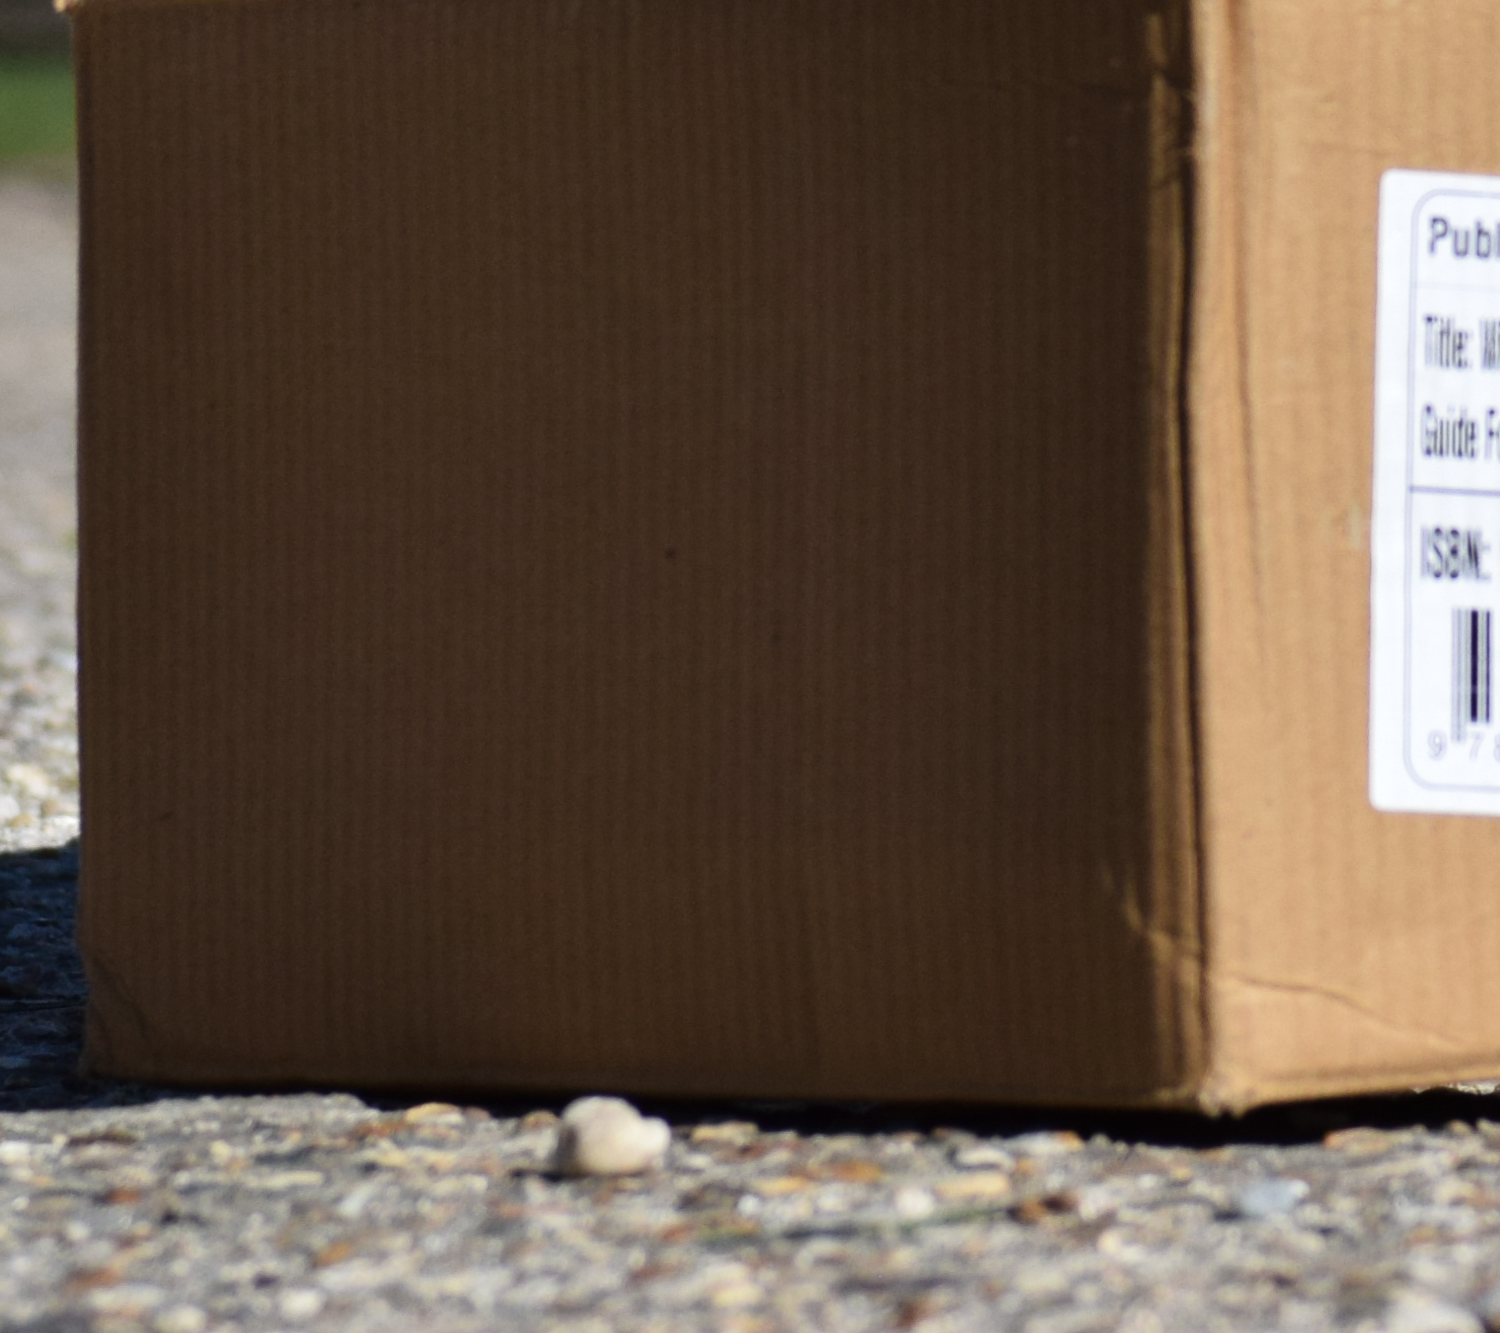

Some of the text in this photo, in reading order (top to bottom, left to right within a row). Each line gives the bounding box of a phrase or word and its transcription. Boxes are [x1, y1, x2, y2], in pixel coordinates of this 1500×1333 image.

[1423, 314, 1470, 370] Title:
[1421, 404, 1477, 459] Guide
[1420, 527, 1491, 581] ISBN:
